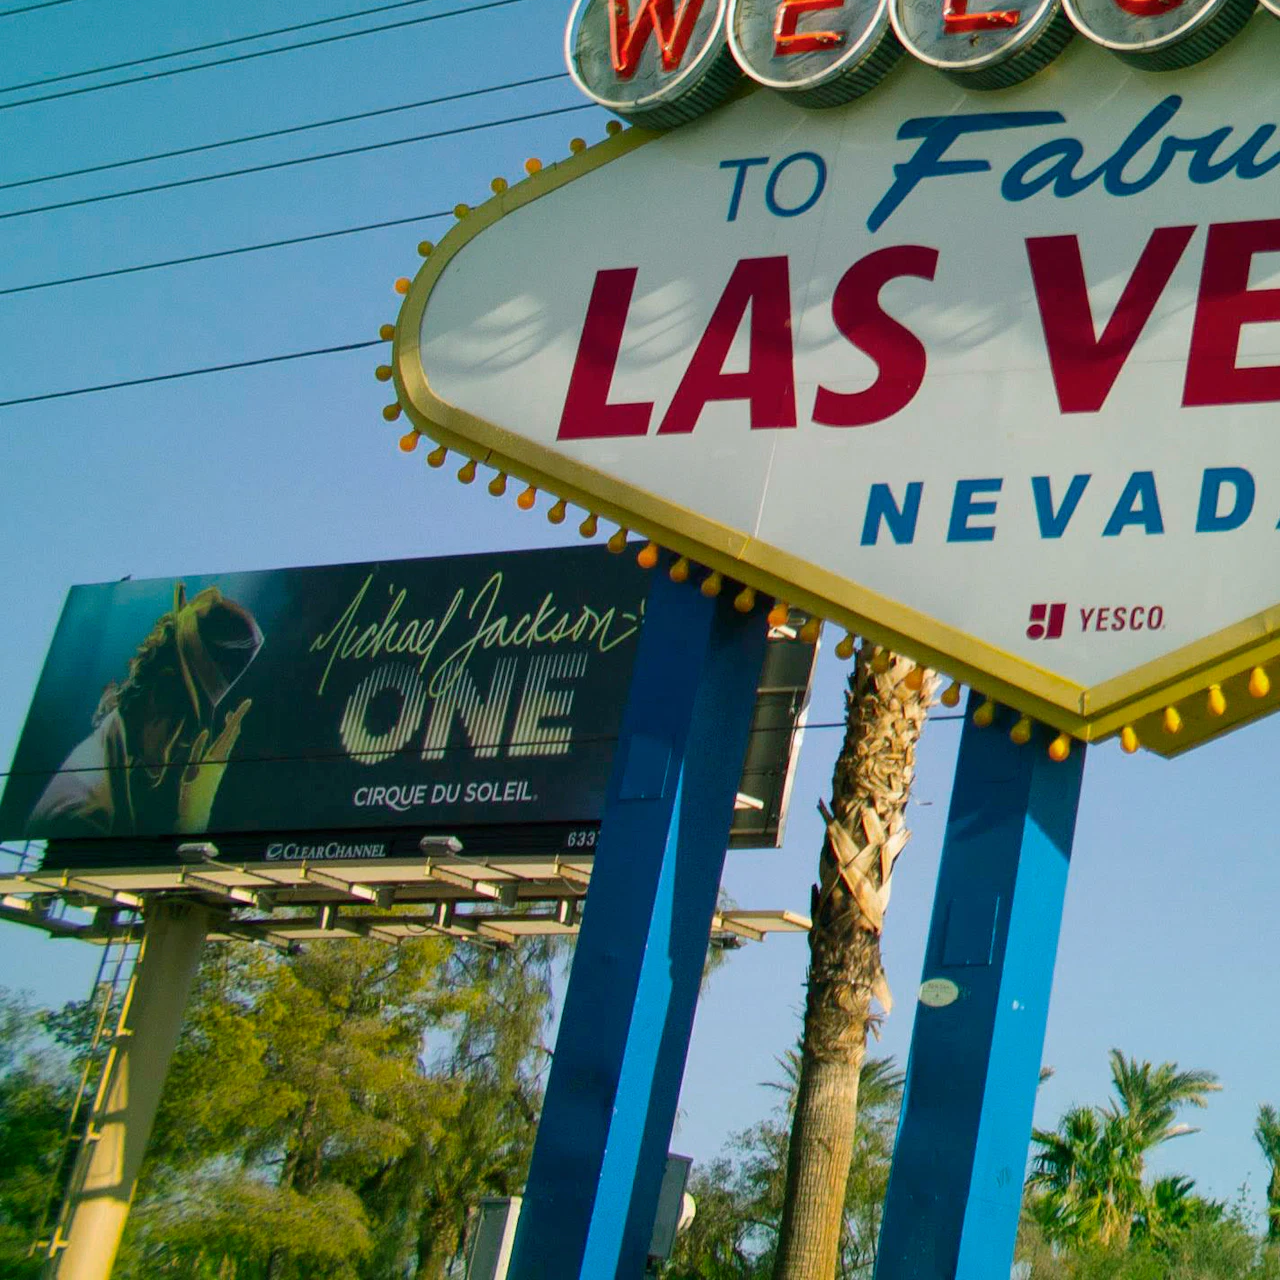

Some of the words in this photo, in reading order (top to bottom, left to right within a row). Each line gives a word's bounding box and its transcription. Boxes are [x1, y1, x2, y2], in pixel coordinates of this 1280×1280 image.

[718, 151, 826, 223] TO
[556, 244, 940, 441] LAS
[309, 573, 464, 696] Michael
[429, 571, 646, 698] Jackson
[1079, 605, 1164, 633] YESCO
[338, 653, 588, 765] ONE
[354, 784, 428, 811] CIRQUE
[431, 783, 461, 804] DU
[464, 781, 532, 802] SOLEIL
[567, 830, 601, 847] 633
